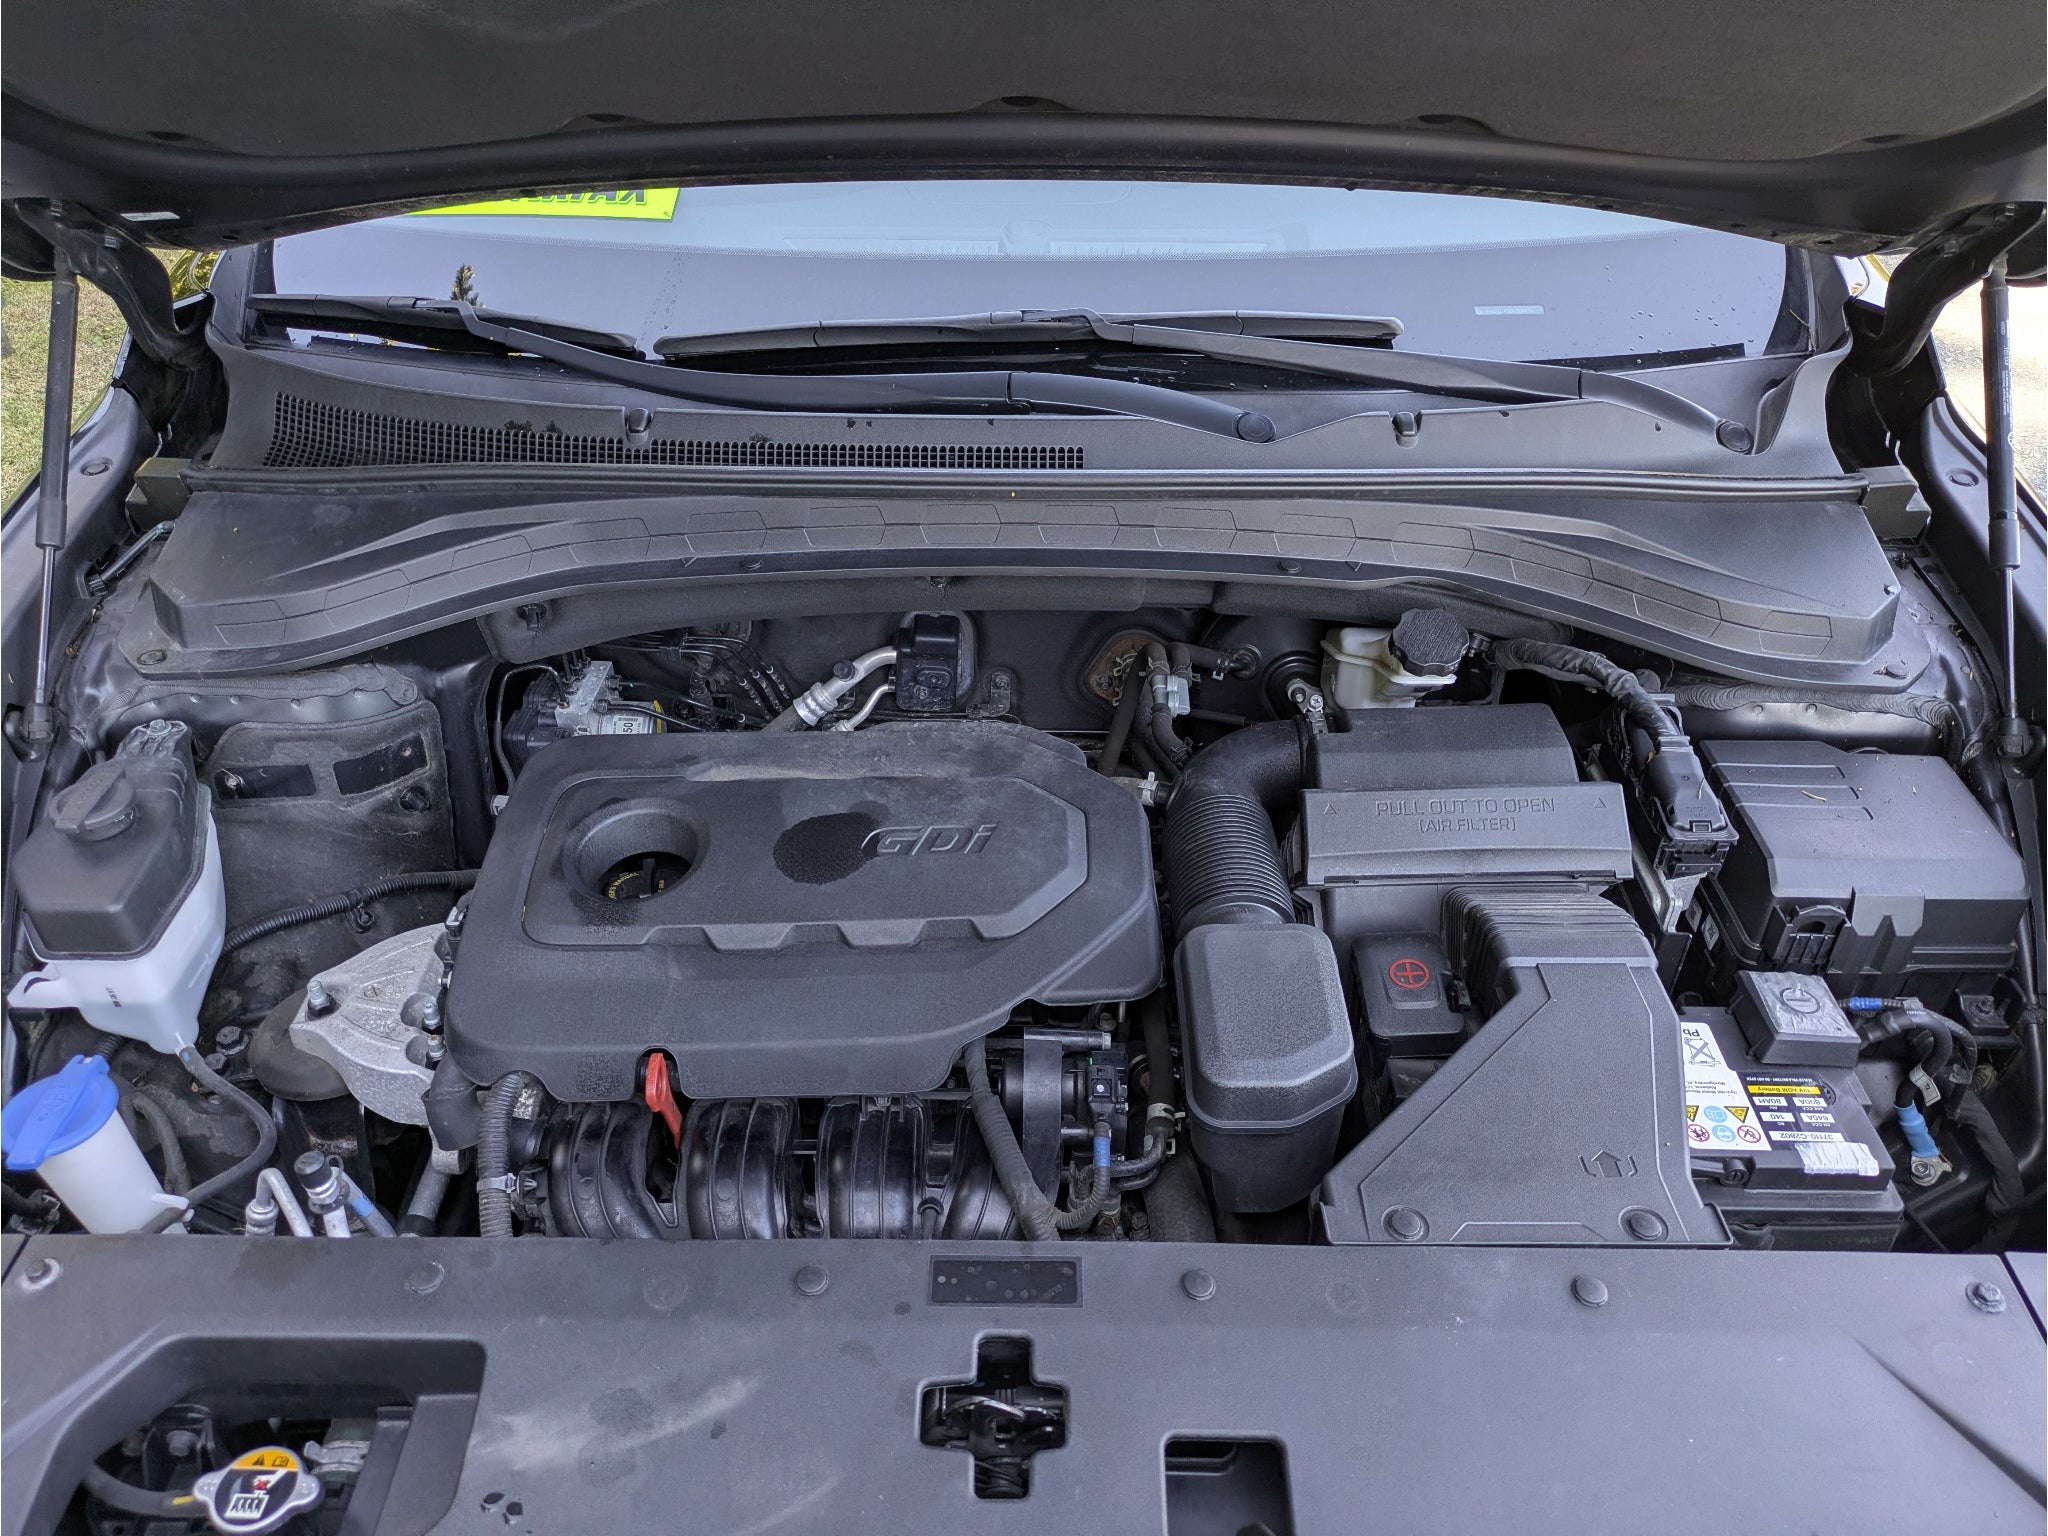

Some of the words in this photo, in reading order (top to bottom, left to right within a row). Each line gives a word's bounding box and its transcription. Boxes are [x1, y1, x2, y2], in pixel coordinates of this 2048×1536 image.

[1376, 800, 1425, 817] PULL
[1429, 799, 1468, 815] OUT
[1473, 798, 1498, 815] TO
[1503, 796, 1555, 814] OPEN
[861, 823, 998, 856] GDi
[1683, 1028, 1700, 1037] Pb
